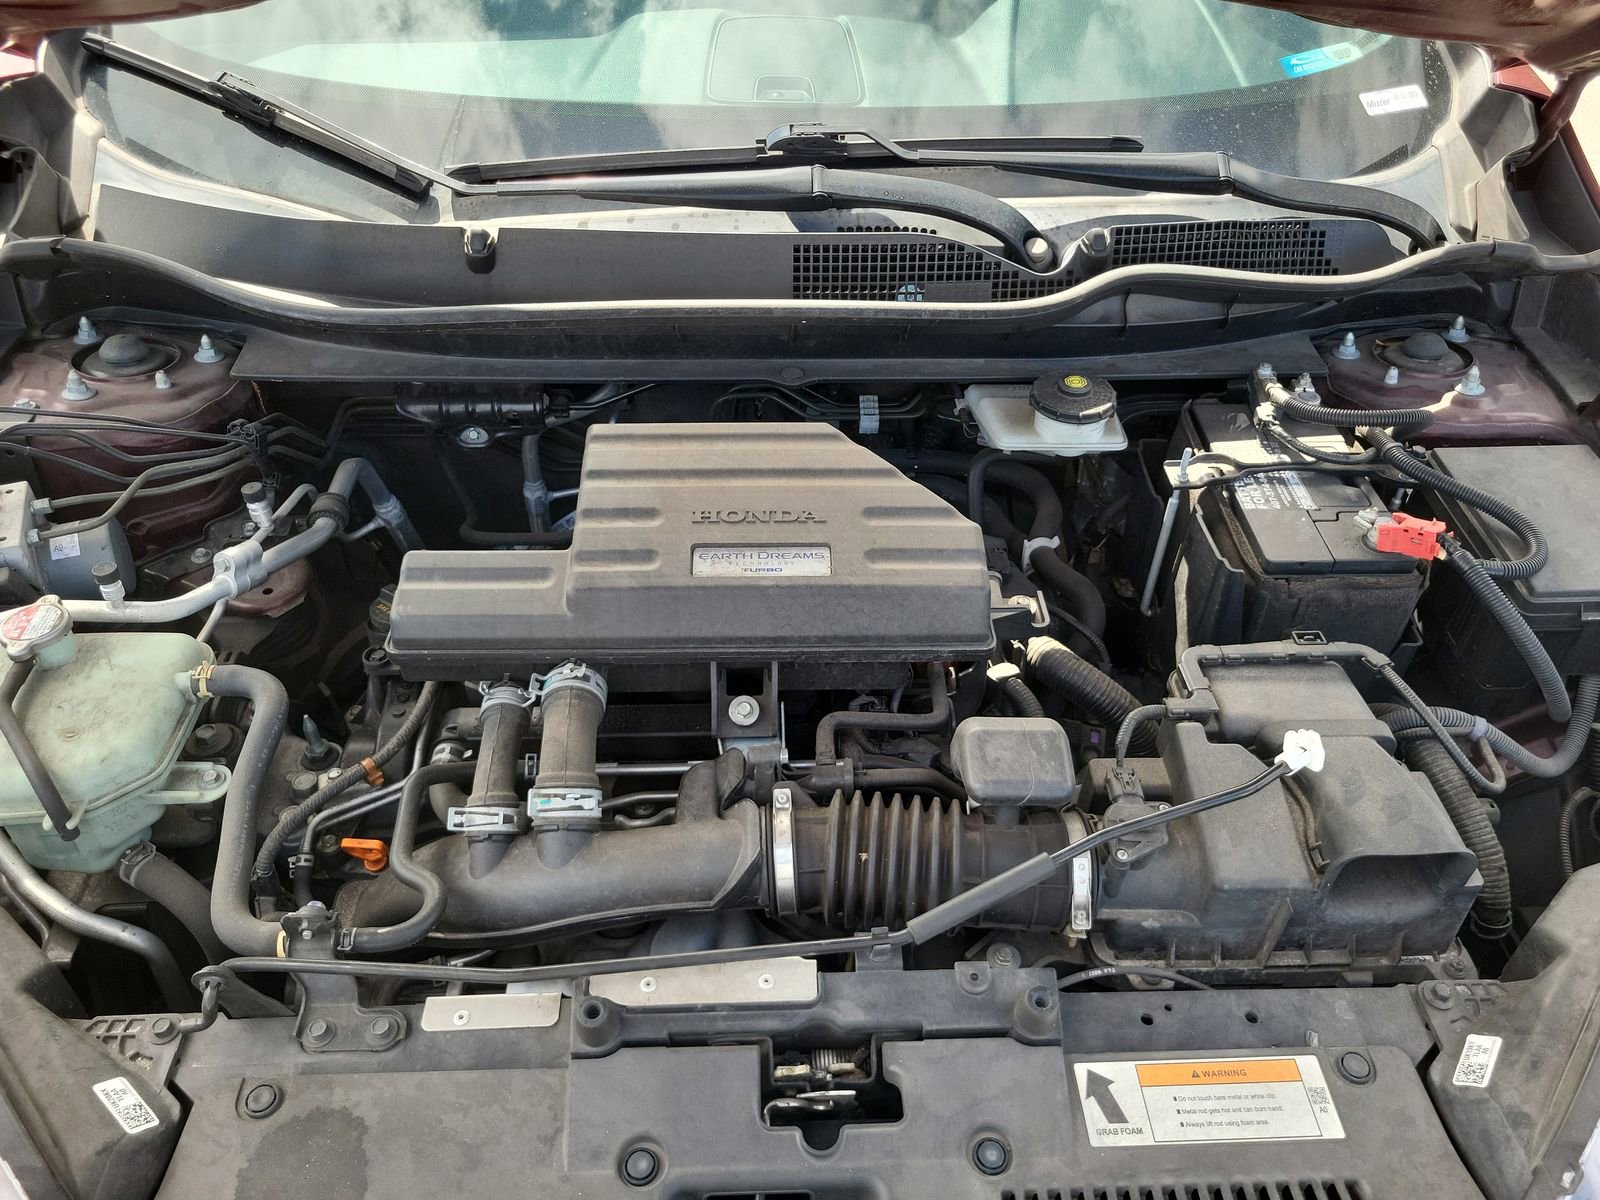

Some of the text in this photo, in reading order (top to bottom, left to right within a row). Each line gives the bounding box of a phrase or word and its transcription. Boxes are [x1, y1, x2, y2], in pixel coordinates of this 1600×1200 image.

[1366, 99, 1390, 109] Mister
[1249, 489, 1267, 509] FOR
[691, 510, 827, 524] HONDA
[699, 551, 825, 560] EARTH DREAMS
[1201, 1069, 1247, 1078] WARNING
[1096, 1127, 1144, 1136] GRAB FOAM
